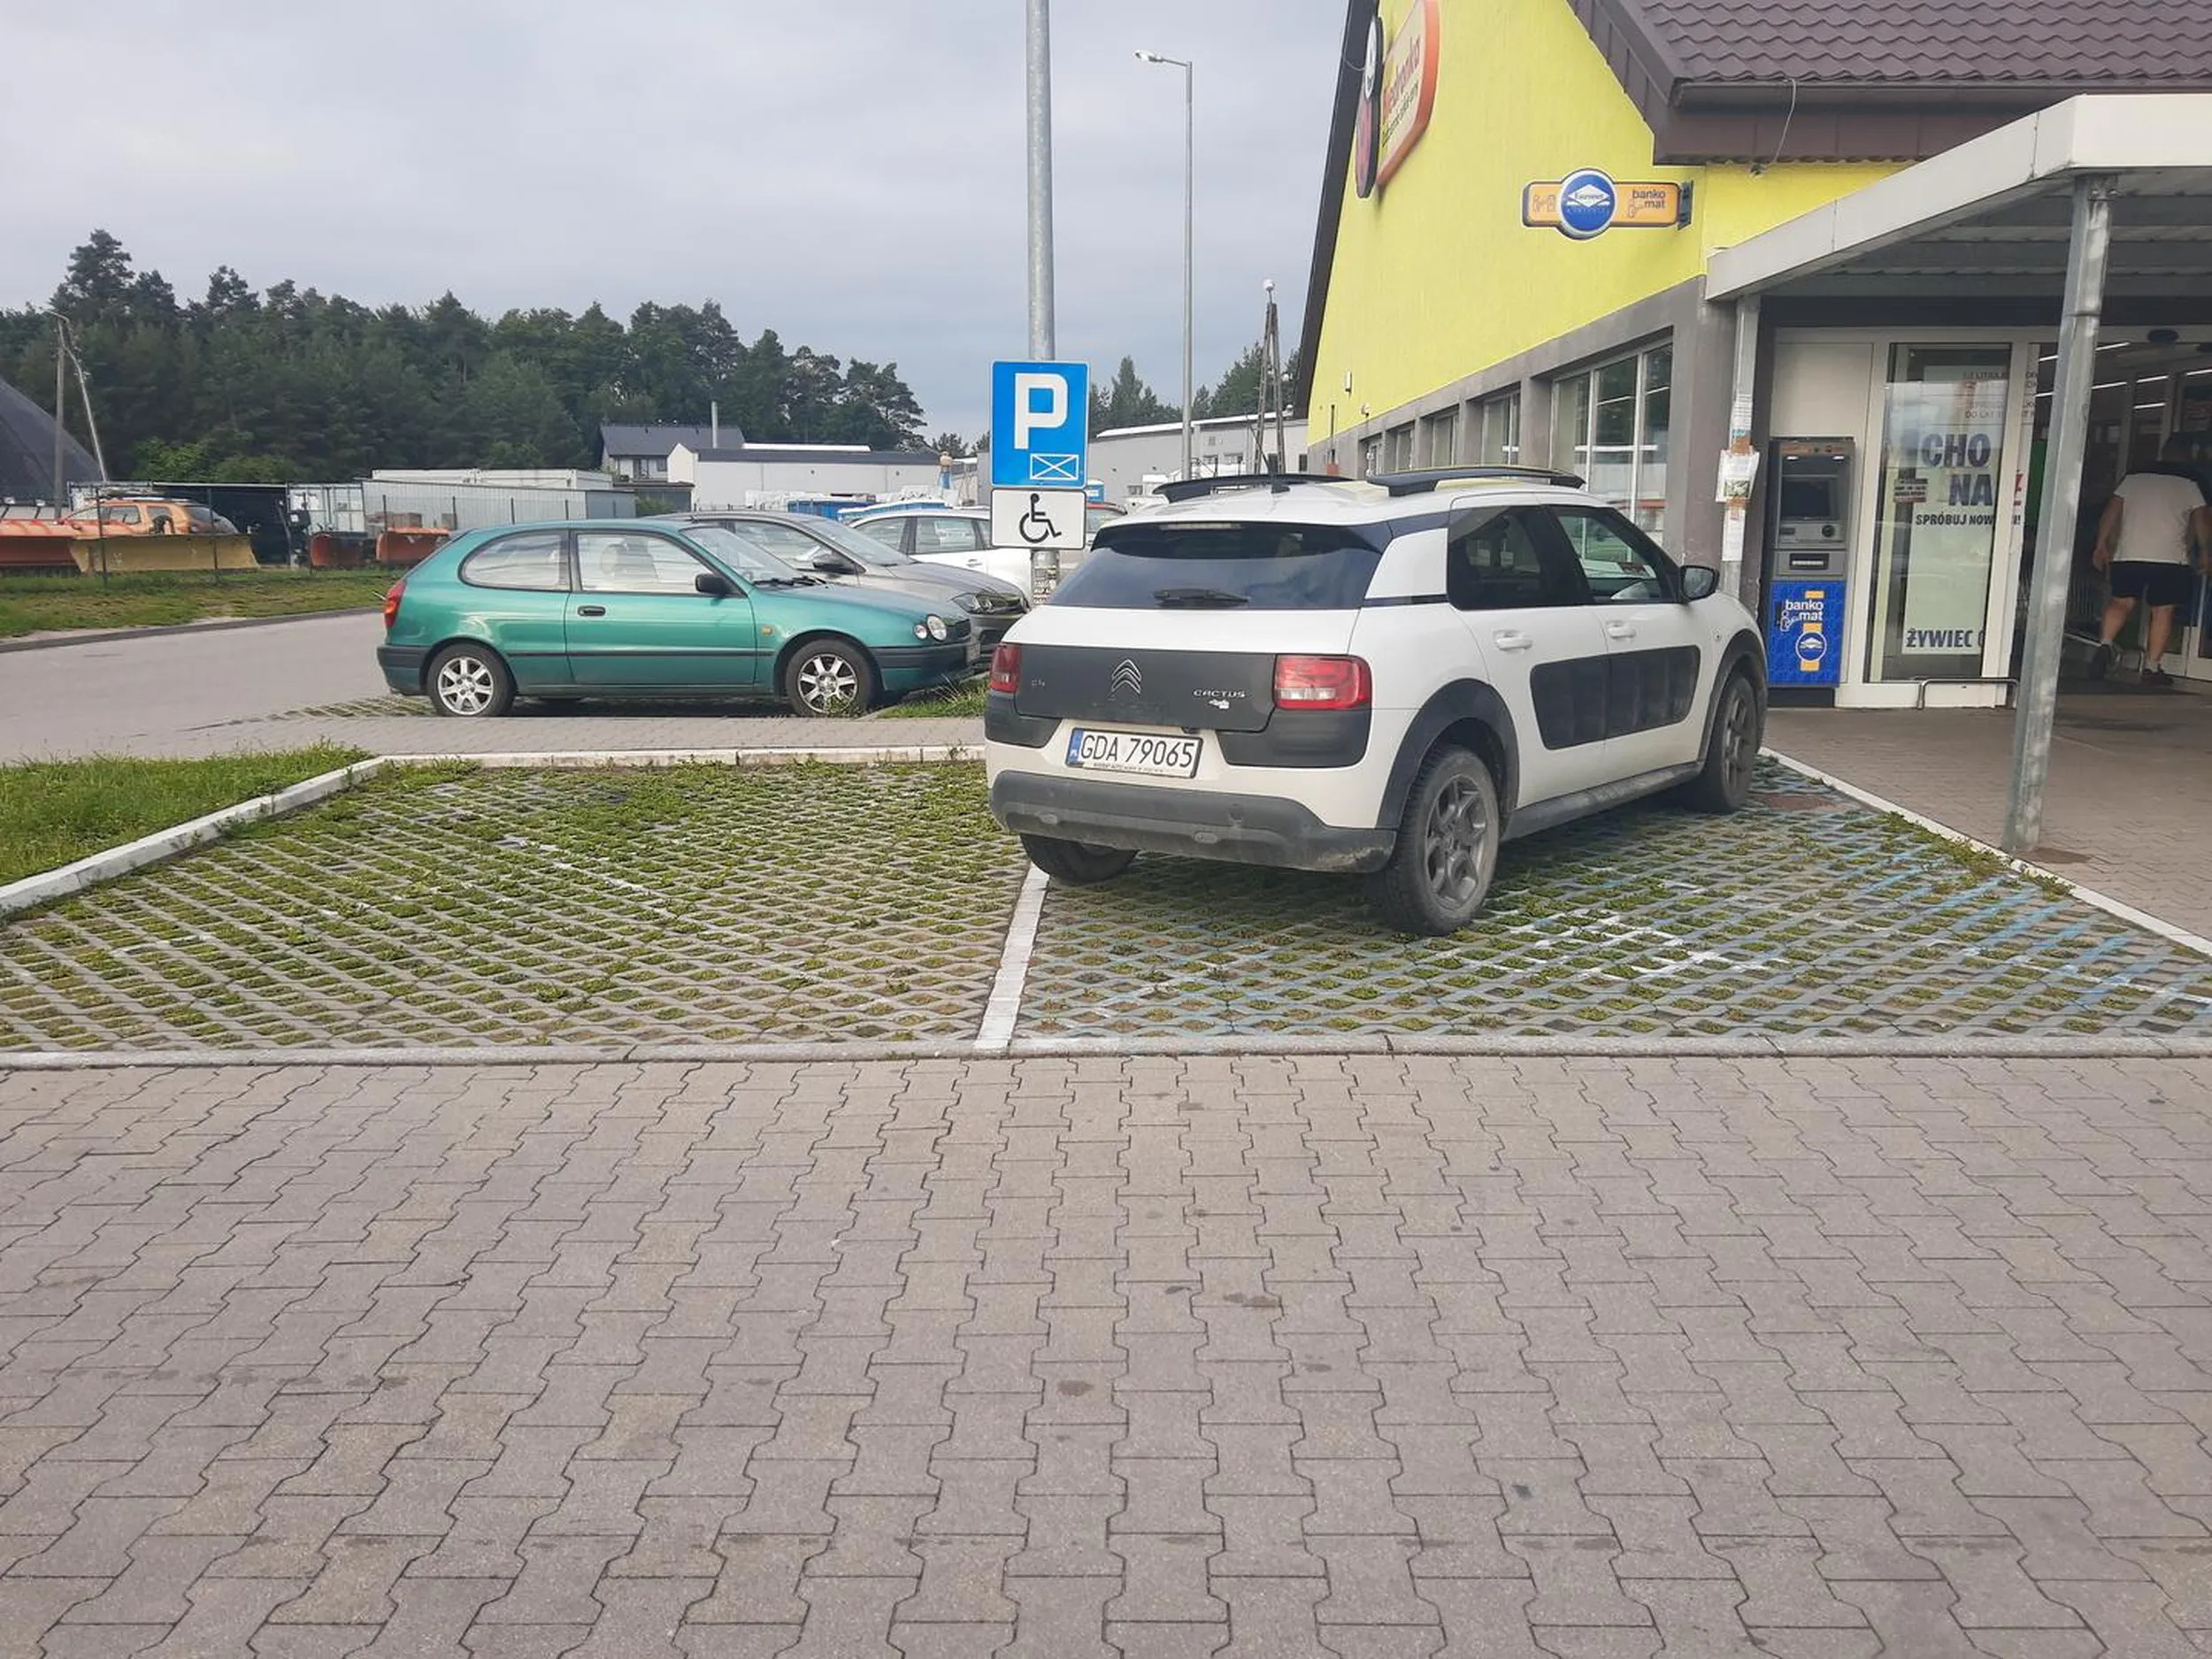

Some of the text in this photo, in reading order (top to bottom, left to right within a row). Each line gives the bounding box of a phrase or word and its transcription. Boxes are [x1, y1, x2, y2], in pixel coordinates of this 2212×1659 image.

[1632, 188, 1666, 199] banko
[1644, 199, 1666, 210] mat
[1014, 373, 1068, 449] P
[1948, 473, 1993, 506] NA
[1916, 511, 1967, 525] SPRÓBUJ
[1786, 599, 1824, 611] banko
[1799, 611, 1824, 620] mat
[1906, 627, 1973, 648] ŻYWIEC
[1193, 689, 1246, 698] CACTUS
[1080, 734, 1118, 761] GDA
[1125, 737, 1195, 768] 79065
